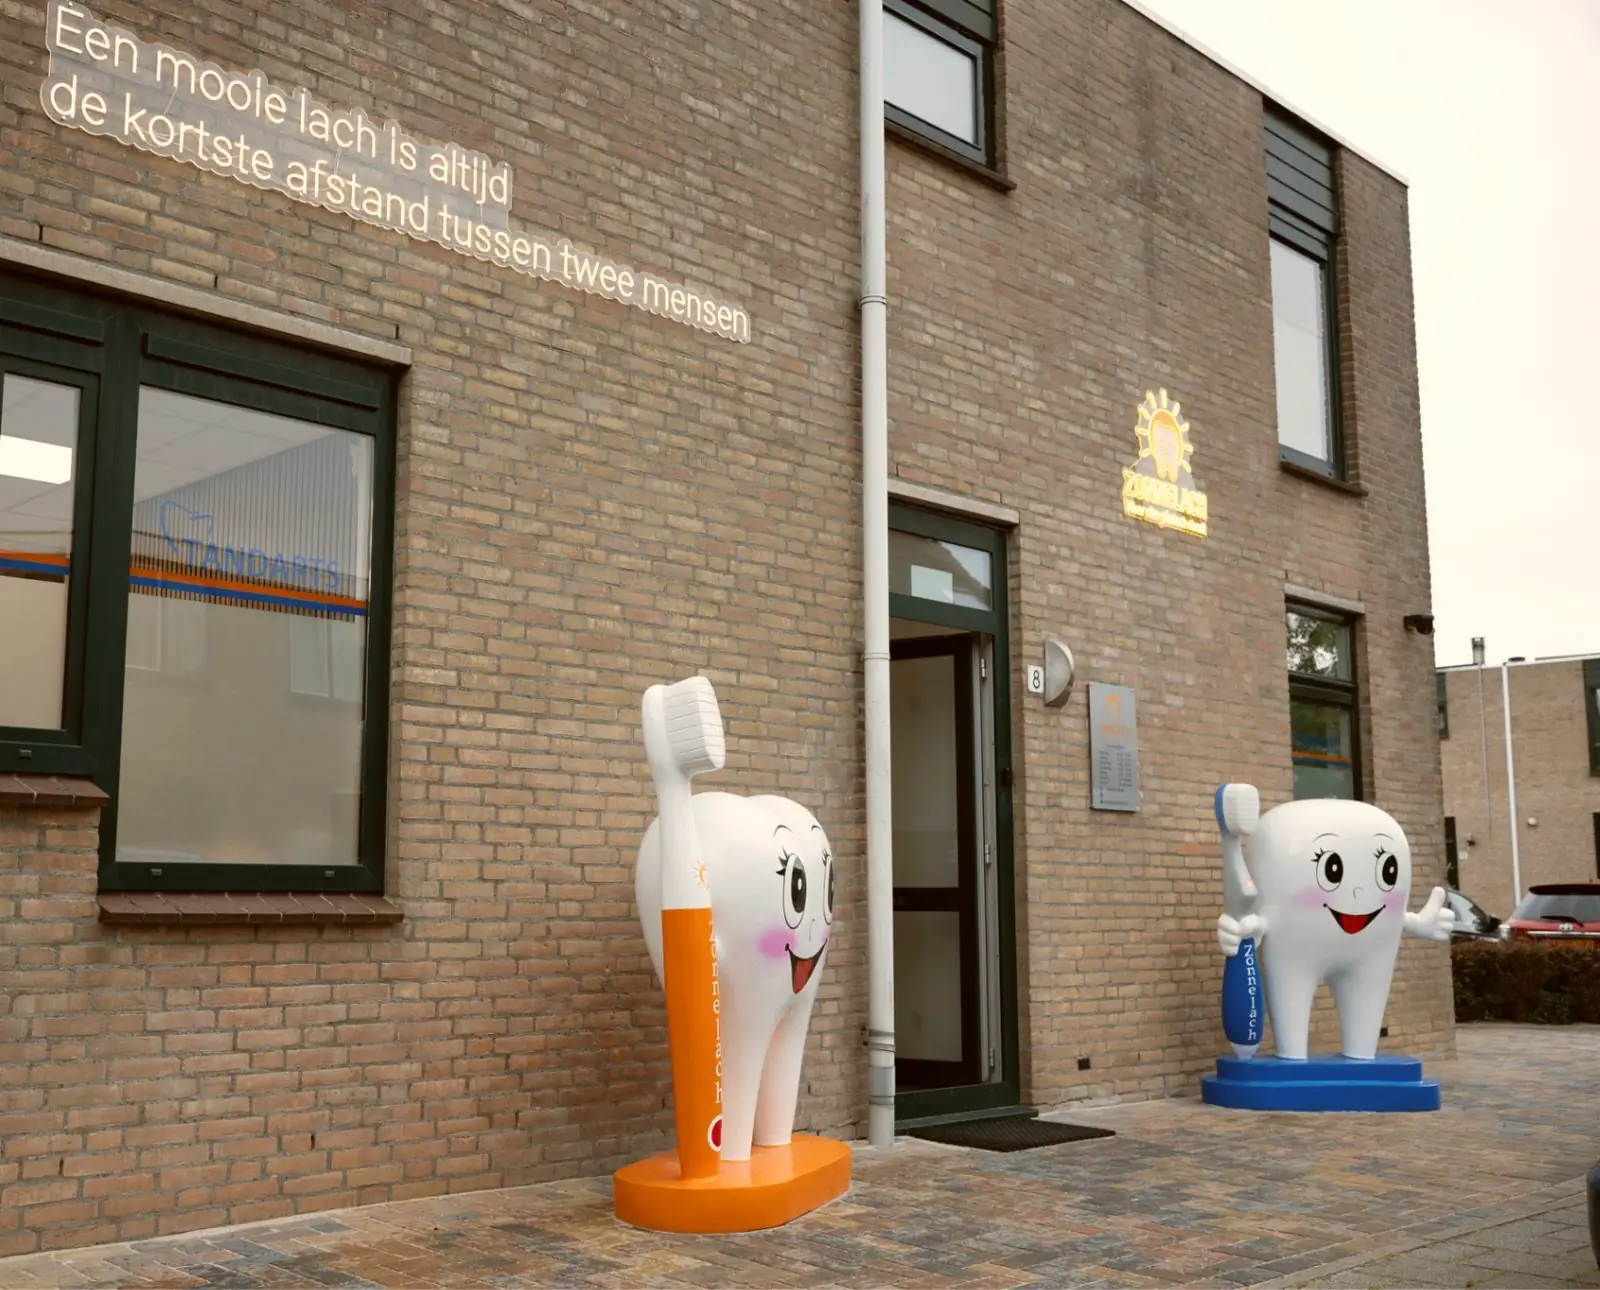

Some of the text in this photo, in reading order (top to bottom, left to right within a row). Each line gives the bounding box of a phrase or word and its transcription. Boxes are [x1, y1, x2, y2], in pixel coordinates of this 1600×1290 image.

[55, 4, 508, 205] Een mooie lach is altijd
[49, 75, 748, 337] de kortste afstand tussen twee mensen
[180, 537, 341, 590] TANDARTS
[1032, 669, 1041, 689] 8
[1244, 944, 1257, 1041] Zonnelach
